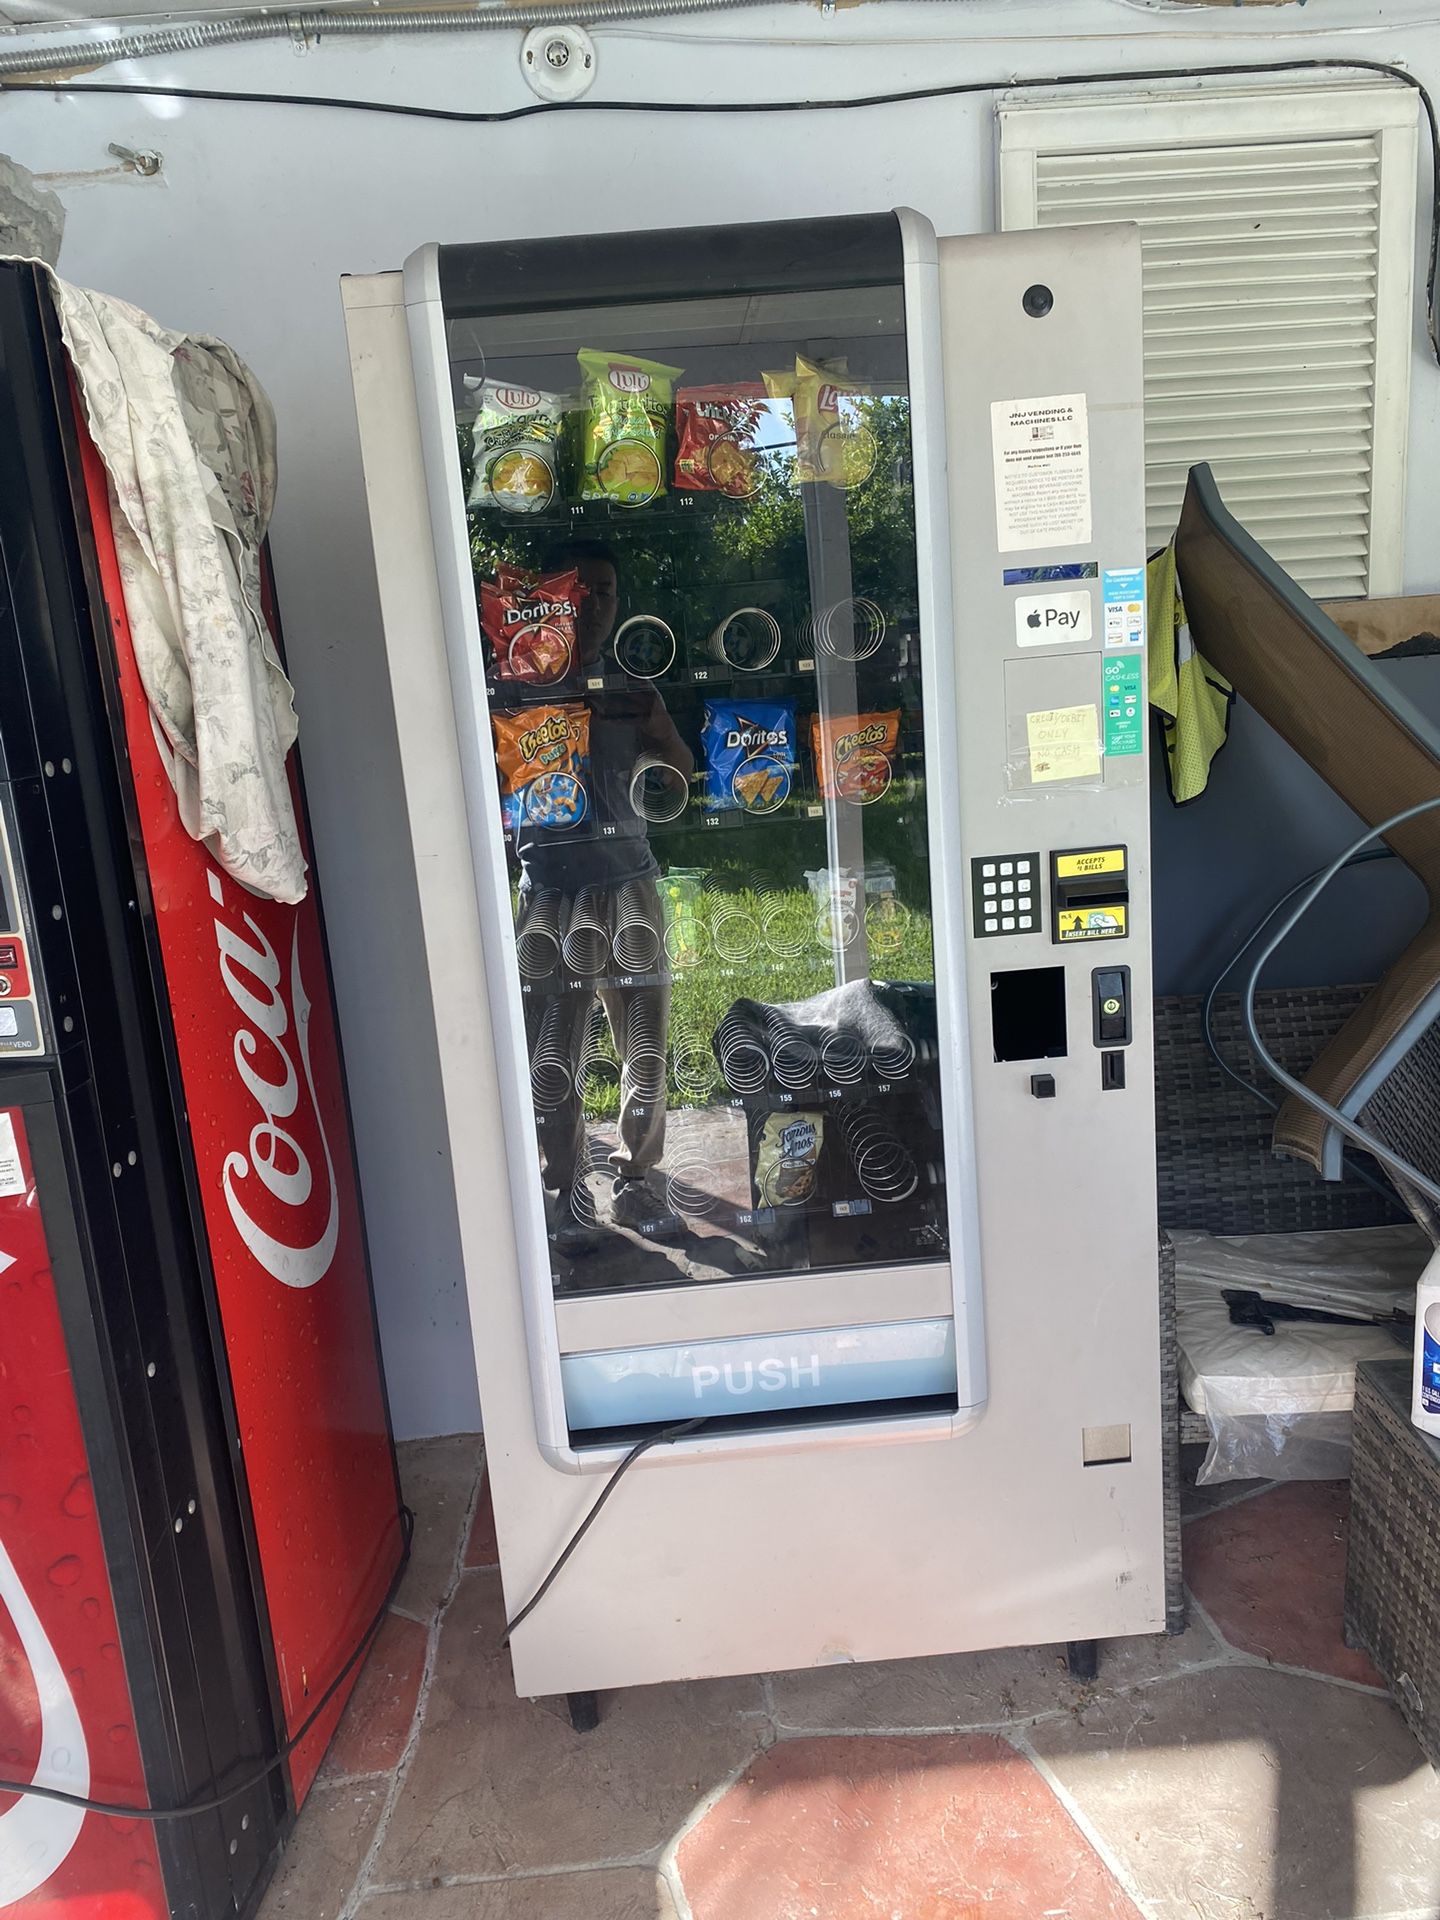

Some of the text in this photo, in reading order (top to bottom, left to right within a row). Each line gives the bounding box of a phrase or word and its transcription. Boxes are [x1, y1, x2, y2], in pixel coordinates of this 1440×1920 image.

[1009, 411, 1027, 419] JNJ
[1028, 407, 1066, 417] VENDING
[1010, 417, 1056, 427] MACHINES
[680, 497, 694, 506] 112
[570, 506, 584, 514] 111
[507, 600, 572, 625] Doritos
[1045, 608, 1080, 629] Pay
[1105, 666, 1120, 675] GO
[694, 671, 708, 680] 122
[1038, 728, 1069, 740] ONLY
[519, 717, 569, 761] Cheetos
[727, 730, 788, 748] Doritos
[834, 724, 887, 762] Cheetos
[706, 817, 719, 826] 132
[603, 826, 615, 835] 131
[1077, 856, 1106, 866] ACCEPTS
[1084, 863, 1103, 871] BILLS
[1065, 927, 1117, 938] INSERT BILL HERE
[772, 963, 784, 971] 145
[671, 972, 684, 981] 143
[721, 968, 734, 976] 144
[569, 981, 582, 989] 141
[620, 977, 633, 986] 142
[14, 1040, 32, 1048] VEND
[878, 1084, 891, 1093] 157
[780, 1094, 793, 1102] 155
[829, 1089, 842, 1098] 156
[731, 1098, 744, 1107] 154
[681, 1103, 694, 1112] 153
[582, 1112, 594, 1120] 151
[631, 1108, 645, 1117] 152
[776, 1122, 817, 1148] Famous
[739, 1214, 752, 1223] 162
[643, 1224, 655, 1233] 161
[692, 1354, 820, 1398] PUSH
